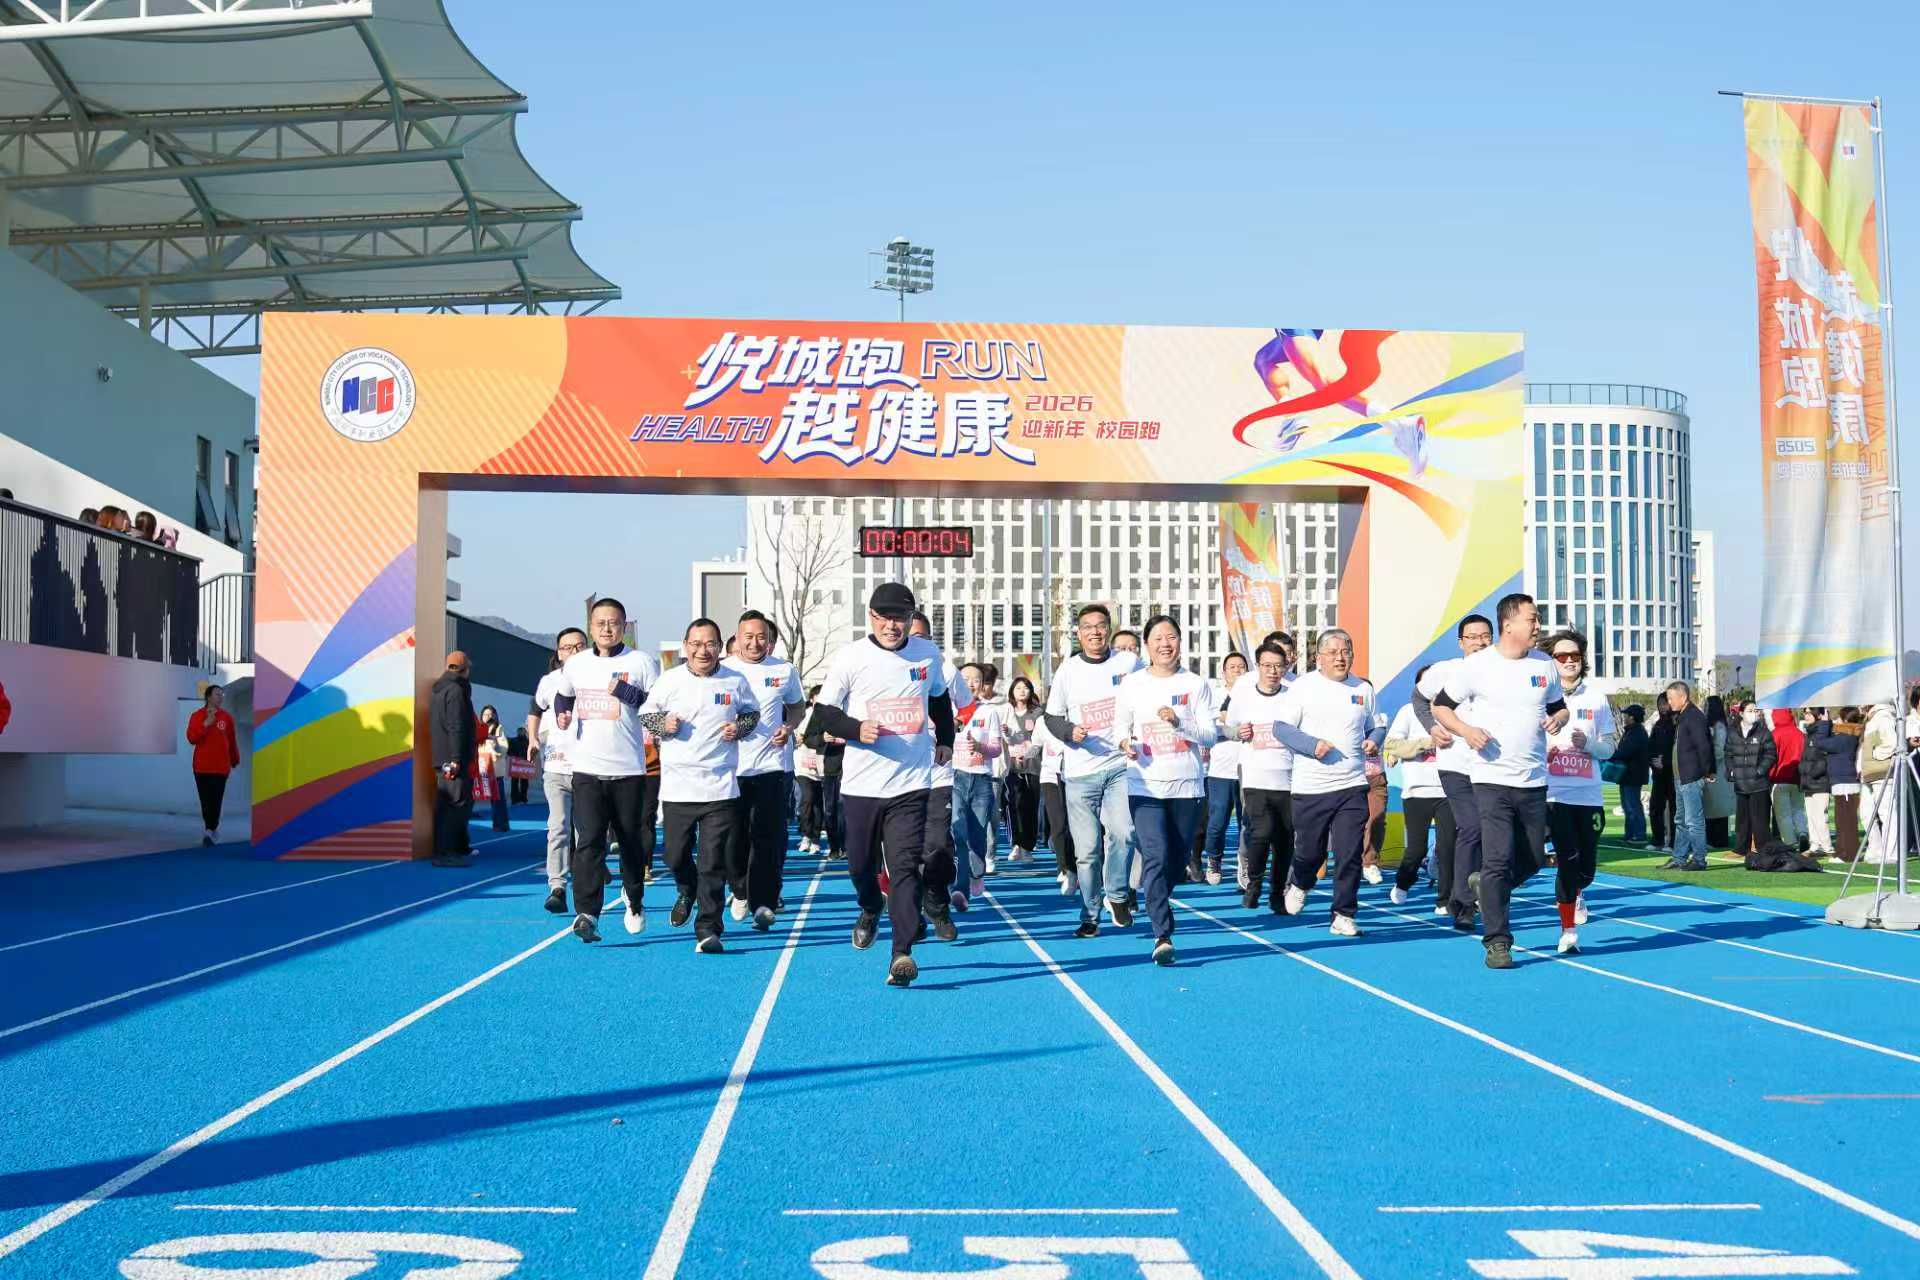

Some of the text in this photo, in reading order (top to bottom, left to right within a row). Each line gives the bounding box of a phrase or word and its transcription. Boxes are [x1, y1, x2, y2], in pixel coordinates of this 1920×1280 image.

[683, 332, 1048, 410] 悦城跑 RUN
[1025, 395, 1094, 412] 2026
[630, 386, 1037, 467] HEALTH 越健康
[1021, 419, 1161, 441] 迎新年 校园跑
[866, 530, 969, 554] 00:00:04
[1552, 756, 1590, 769] A0017
